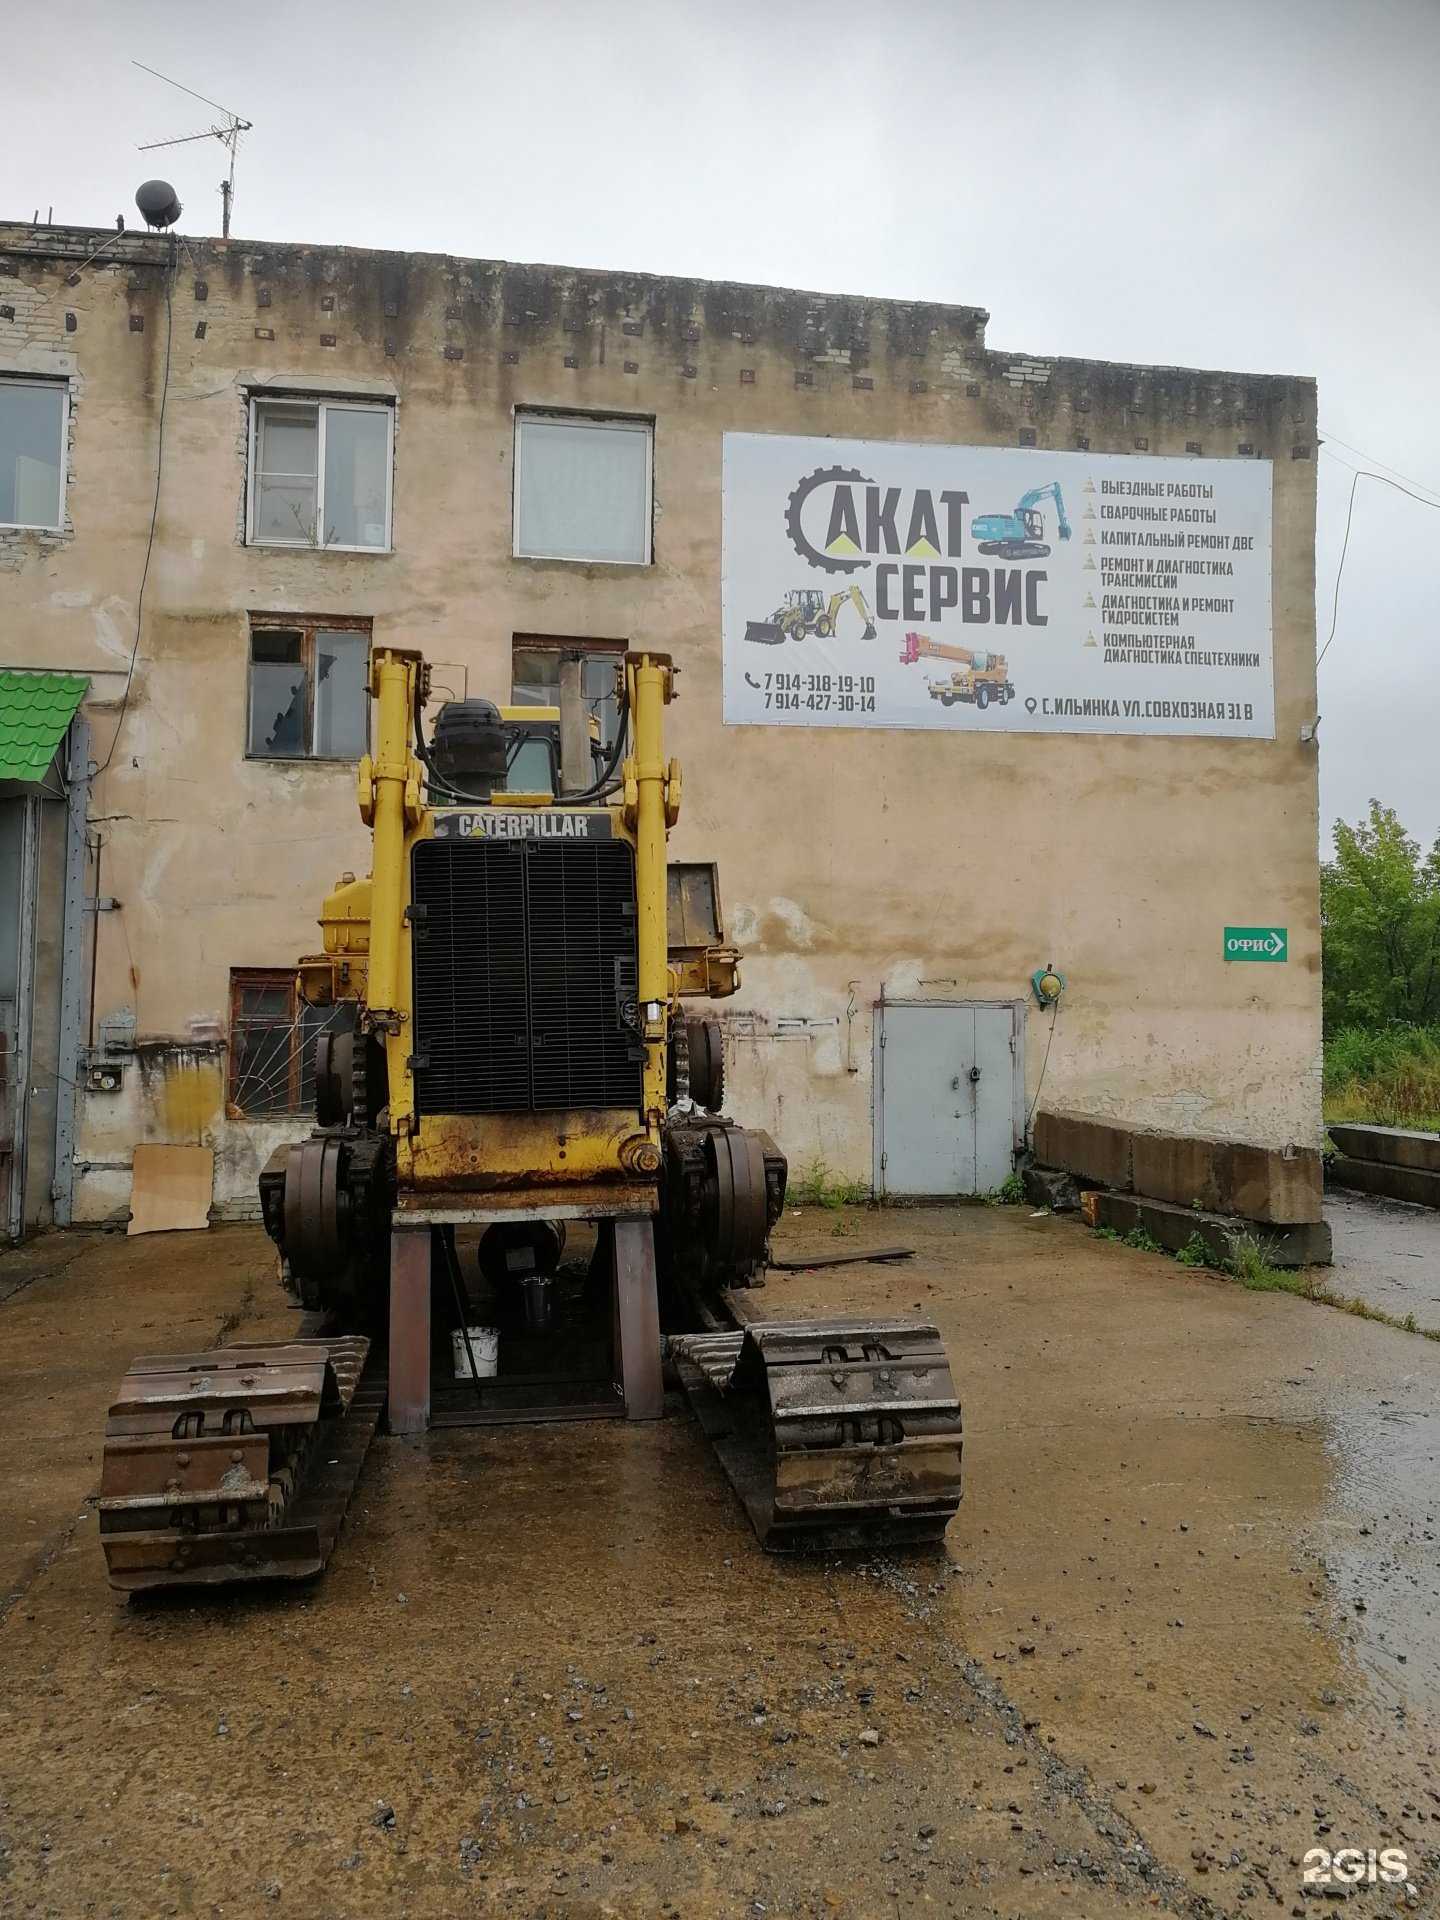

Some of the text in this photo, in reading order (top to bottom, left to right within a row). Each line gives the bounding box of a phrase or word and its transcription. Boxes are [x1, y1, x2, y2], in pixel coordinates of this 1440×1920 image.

[1101, 480, 1213, 498] ВЫЕЗДНЫЕ РАБОТЫ
[824, 485, 970, 558] АКАТ
[1101, 505, 1216, 523] СВАРОЧНЫЕ РАБОТЫ
[1101, 531, 1254, 551] КАПИТАЛЬНЫЙ РЕМОНТ ДВС
[1101, 557, 1234, 576] РЕМОНТ И ДИАГНОСТИКА
[1101, 573, 1178, 589] ТРАНСМИССИИ
[876, 563, 1048, 626] СЕРВИС
[1101, 595, 1234, 613] ДИАГНОСТИКА И РЕМОНТ
[1102, 610, 1179, 626] ГИДРОСИСТЕМ
[1103, 633, 1195, 649] КОМПЬЮТЕРНАЯ
[1104, 649, 1260, 667] ДИАГНОСТИКА СПЕЦТЕХНИКИ
[775, 674, 875, 693] 914-318-19-10
[775, 693, 876, 712] 914-427-30-14
[459, 815, 588, 837] CATERPILLAR
[1227, 938, 1275, 952] ОФИС
